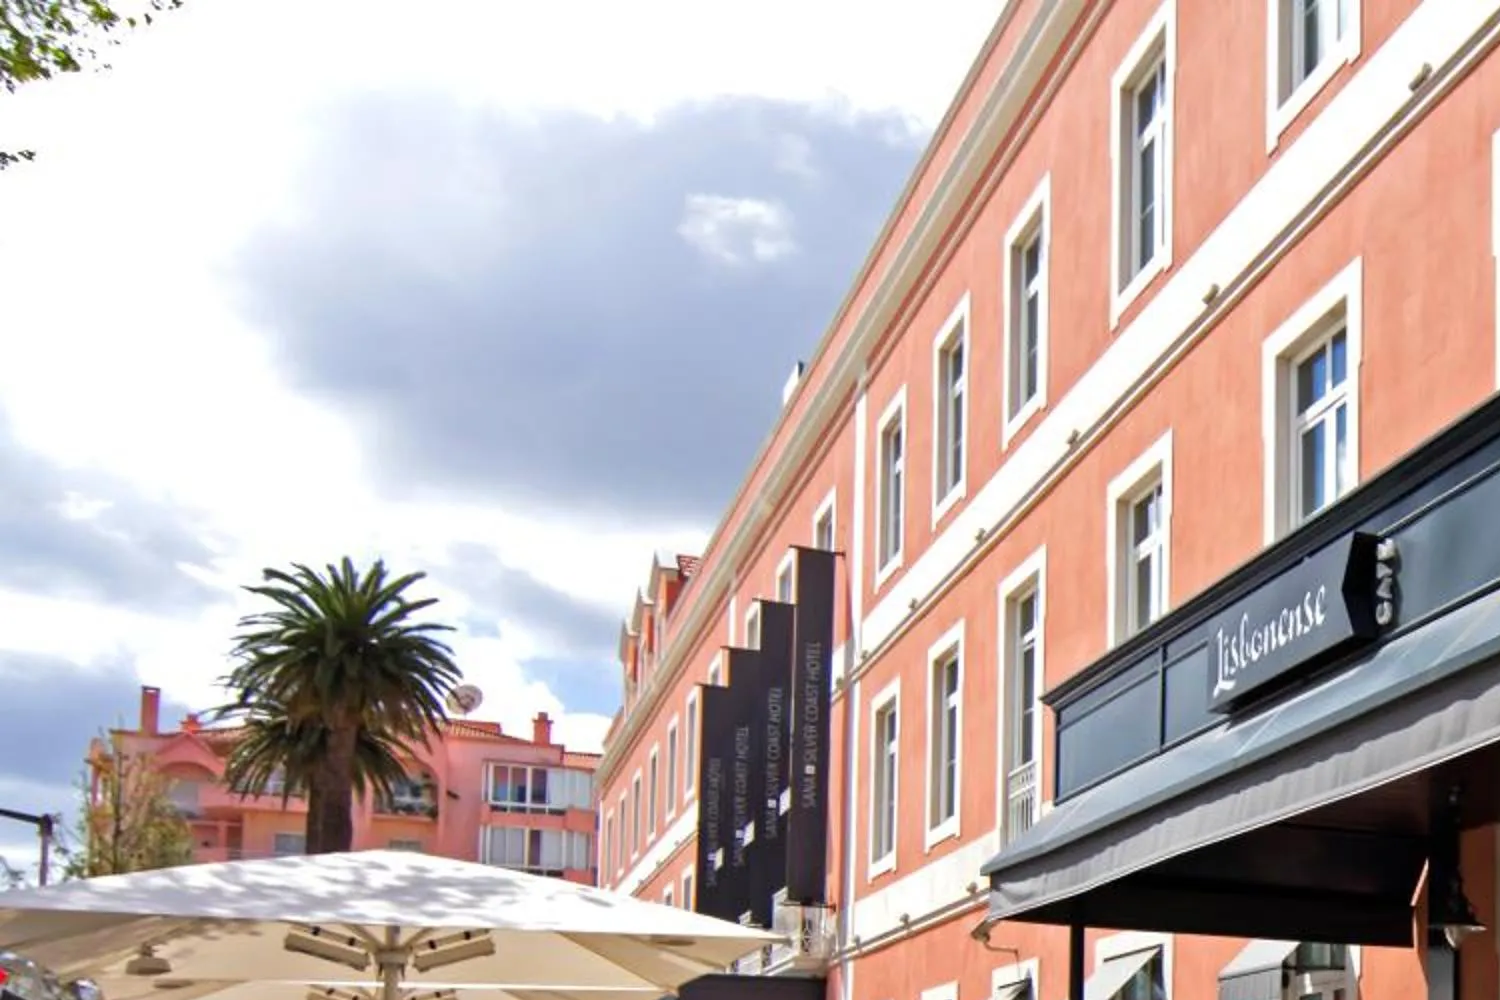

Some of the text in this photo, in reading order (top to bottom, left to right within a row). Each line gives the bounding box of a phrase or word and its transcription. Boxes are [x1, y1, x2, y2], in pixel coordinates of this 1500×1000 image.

[1213, 584, 1326, 698] Lisbonense
[801, 642, 821, 809] SANA SILVER COAST HOTEL
